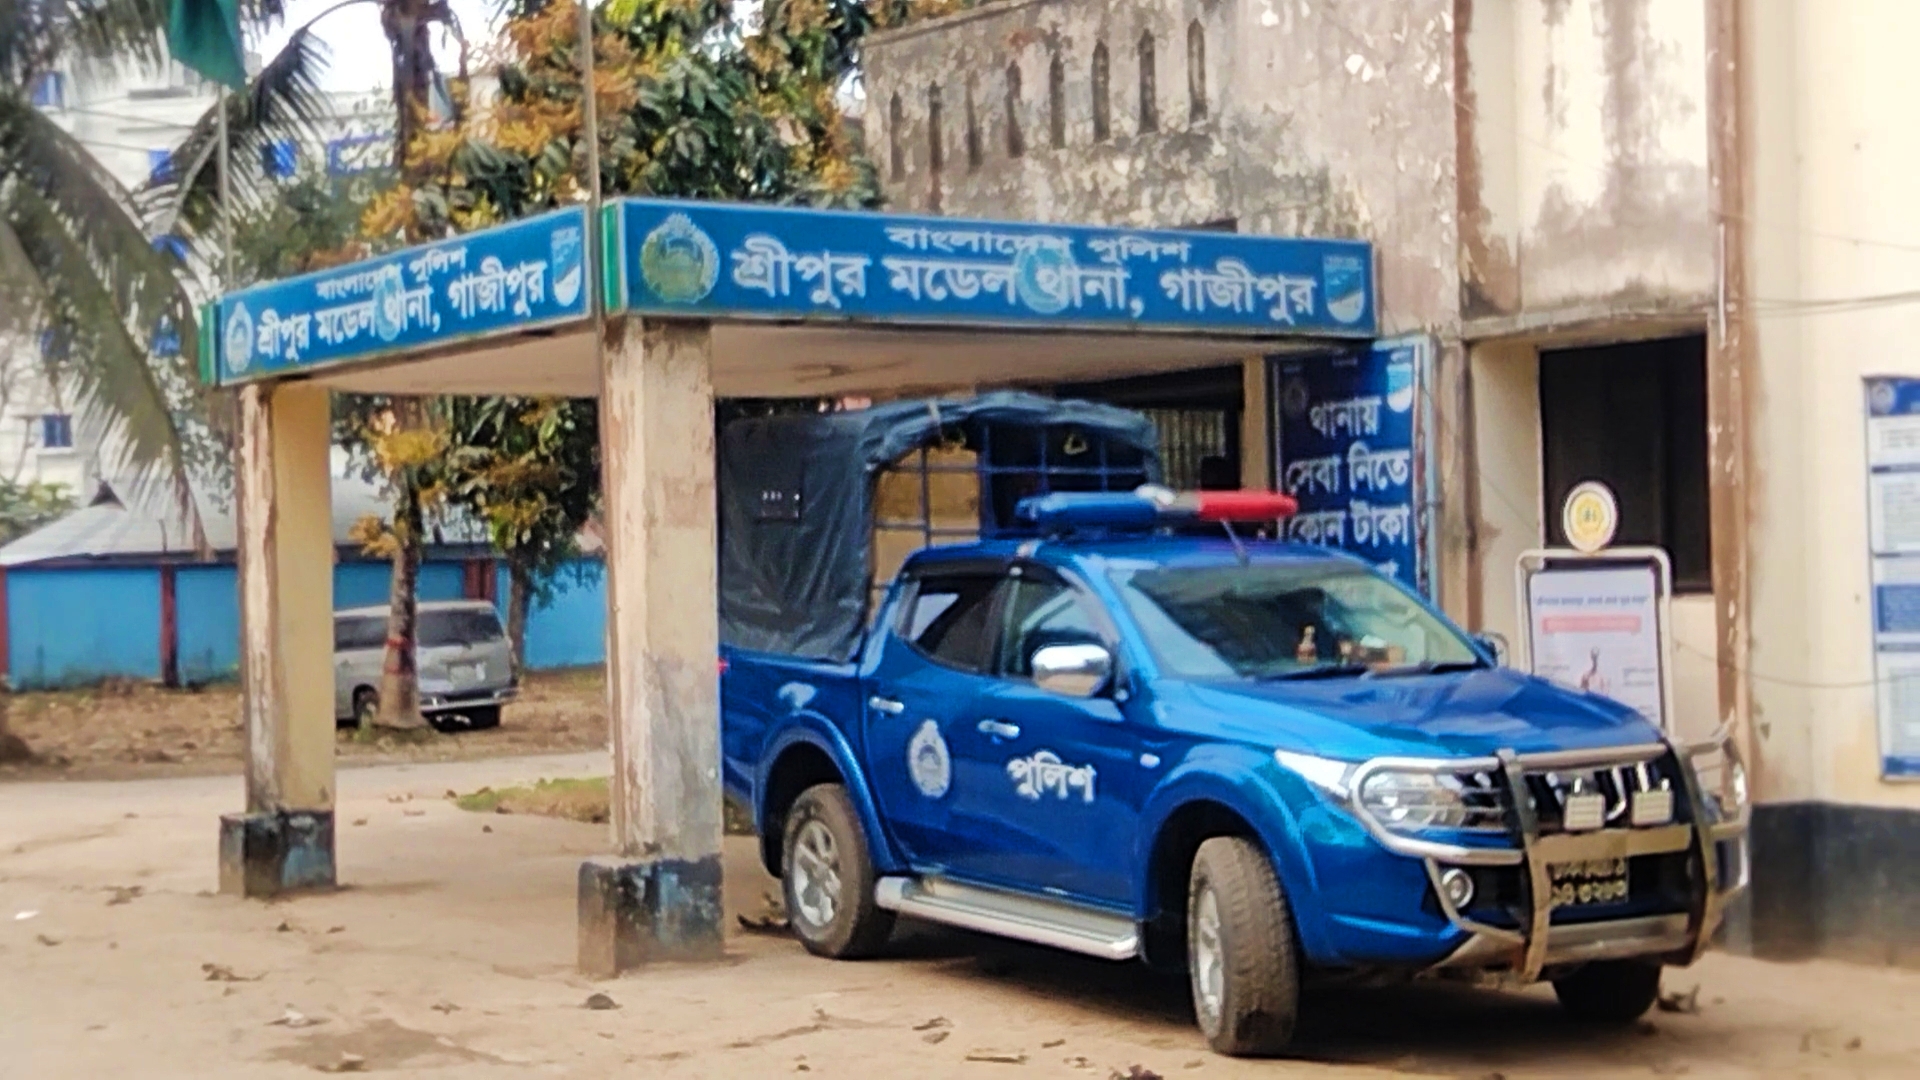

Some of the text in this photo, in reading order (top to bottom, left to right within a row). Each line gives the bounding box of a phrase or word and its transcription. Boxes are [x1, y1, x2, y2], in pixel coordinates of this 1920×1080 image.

[316, 245, 468, 299] বাংলাদেশ পুলিশ
[883, 225, 1192, 265] বাংলাদেশ পুলিশ
[730, 235, 1318, 325] শ্রীপুর মডেল থানা, গাজীপুর
[257, 308, 311, 362] শ্রীপুর
[314, 300, 378, 346] মডেল
[447, 256, 548, 318] গাজীপুর
[1309, 396, 1382, 440] থানায়
[1286, 440, 1411, 496] সেবা নিতে
[1288, 497, 1410, 549] কোন টাকা
[1006, 749, 1098, 803] পুলিশ
